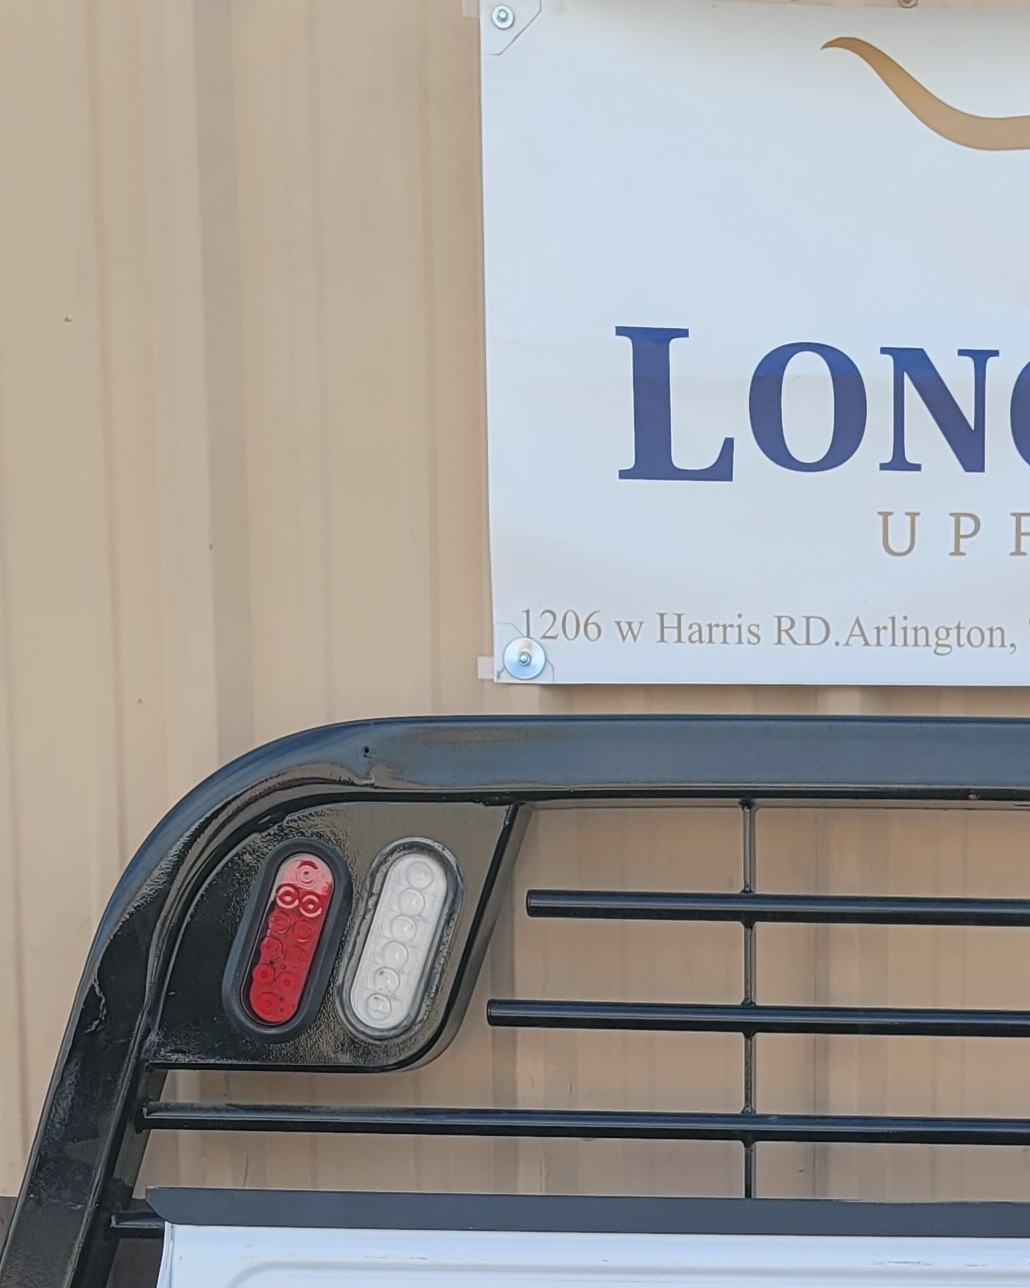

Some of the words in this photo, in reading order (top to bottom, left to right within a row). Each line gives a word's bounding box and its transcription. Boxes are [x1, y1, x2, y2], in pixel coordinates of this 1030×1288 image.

[521, 607, 603, 642] 1206
[613, 620, 645, 643] w
[655, 612, 761, 647] Harris
